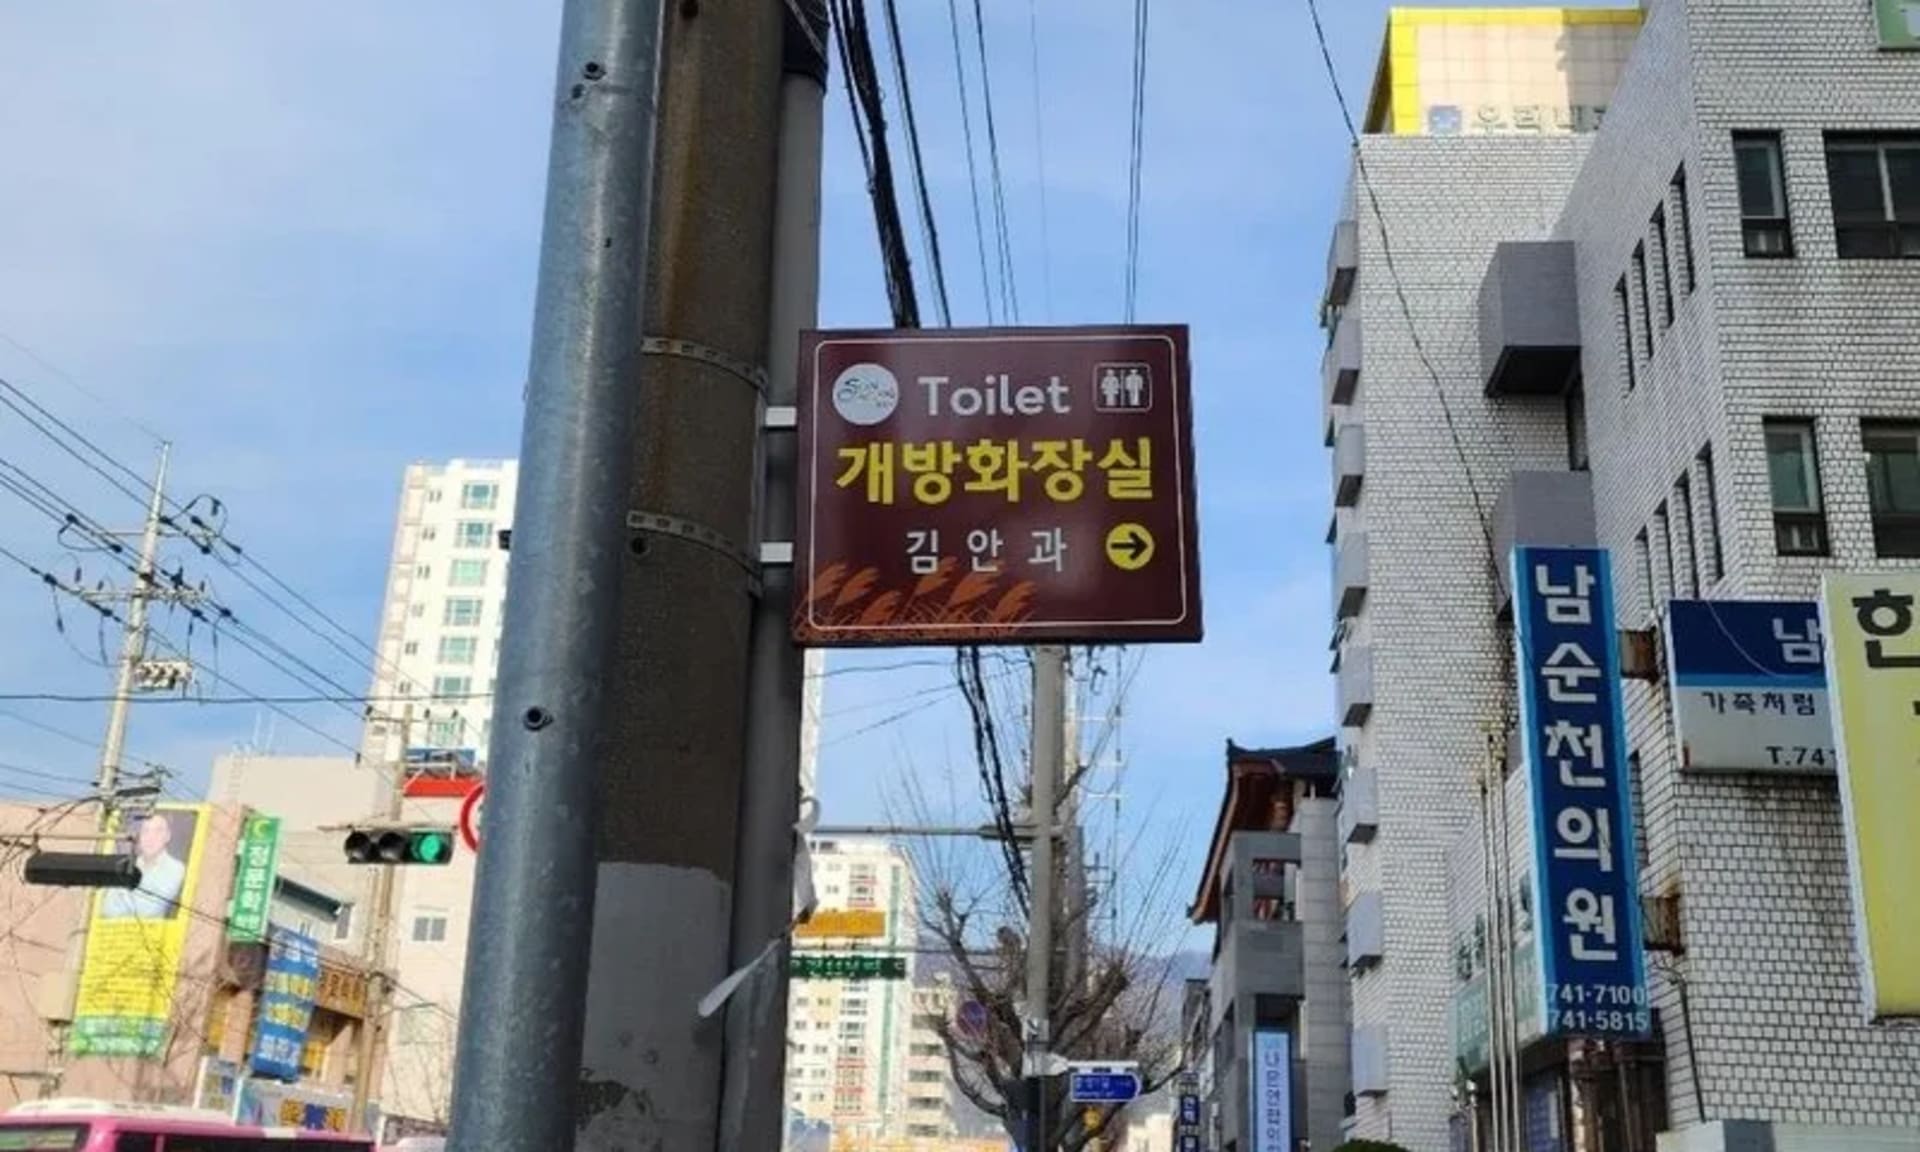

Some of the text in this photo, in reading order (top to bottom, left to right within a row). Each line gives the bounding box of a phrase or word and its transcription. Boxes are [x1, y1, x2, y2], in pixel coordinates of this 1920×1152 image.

[918, 375, 1072, 416] Toilet
[836, 437, 1153, 505] 개방화장실
[1702, 691, 1816, 716] 가족처럼
[1535, 564, 1618, 961] 남순천의원
